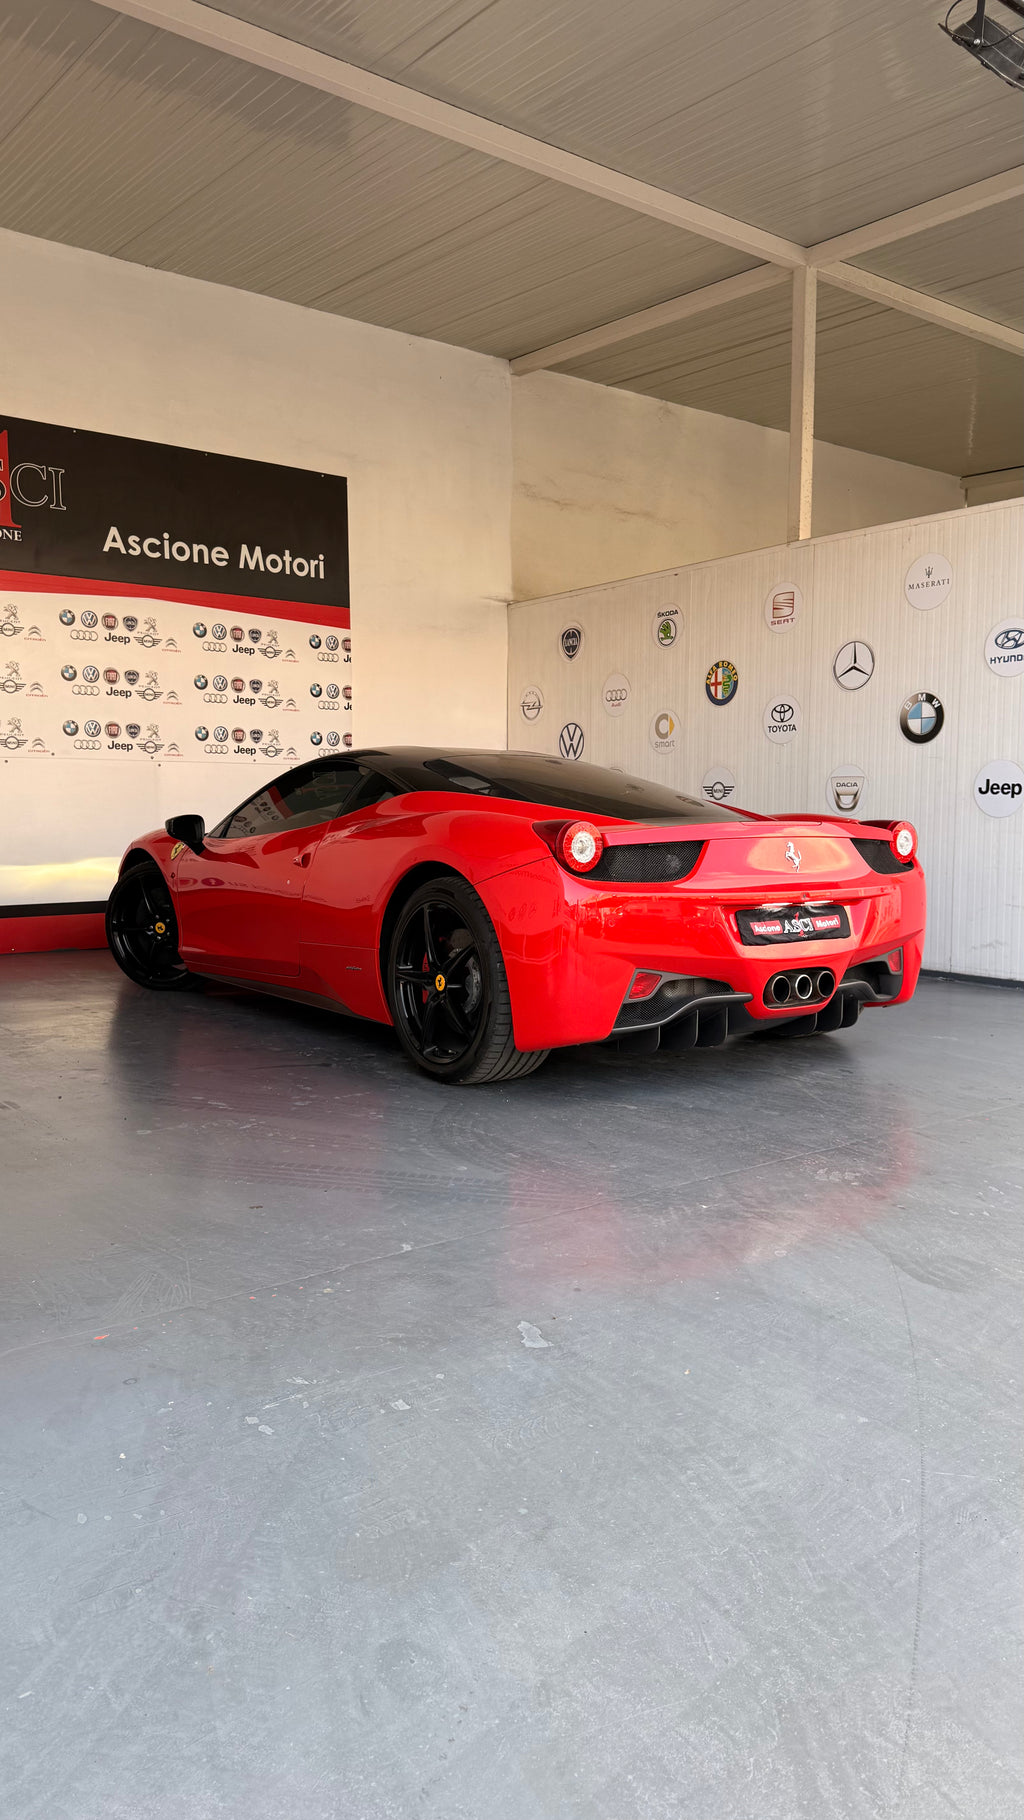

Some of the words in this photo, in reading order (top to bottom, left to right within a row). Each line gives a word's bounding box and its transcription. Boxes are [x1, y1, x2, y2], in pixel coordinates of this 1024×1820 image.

[0, 529, 22, 541] NE
[103, 526, 229, 567] Ascione
[239, 544, 325, 579] Motori
[908, 578, 950, 590] MASERATI
[657, 609, 679, 618] ŠKODA
[770, 617, 795, 626] SEAT
[104, 632, 131, 645] Jeep
[232, 644, 255, 656] Jeep
[706, 665, 717, 684] ALFA
[719, 661, 738, 681] ROMEO
[106, 686, 132, 699] Jeep
[233, 695, 256, 706] Jeep
[903, 693, 941, 710] BMW
[768, 724, 797, 733] TOYOTA
[107, 740, 133, 752] Jeep
[654, 740, 675, 748] smart
[234, 745, 256, 756] Jeep
[978, 779, 1022, 798] Jeep
[784, 917, 814, 933] ASCI
[815, 917, 839, 928] Motori
